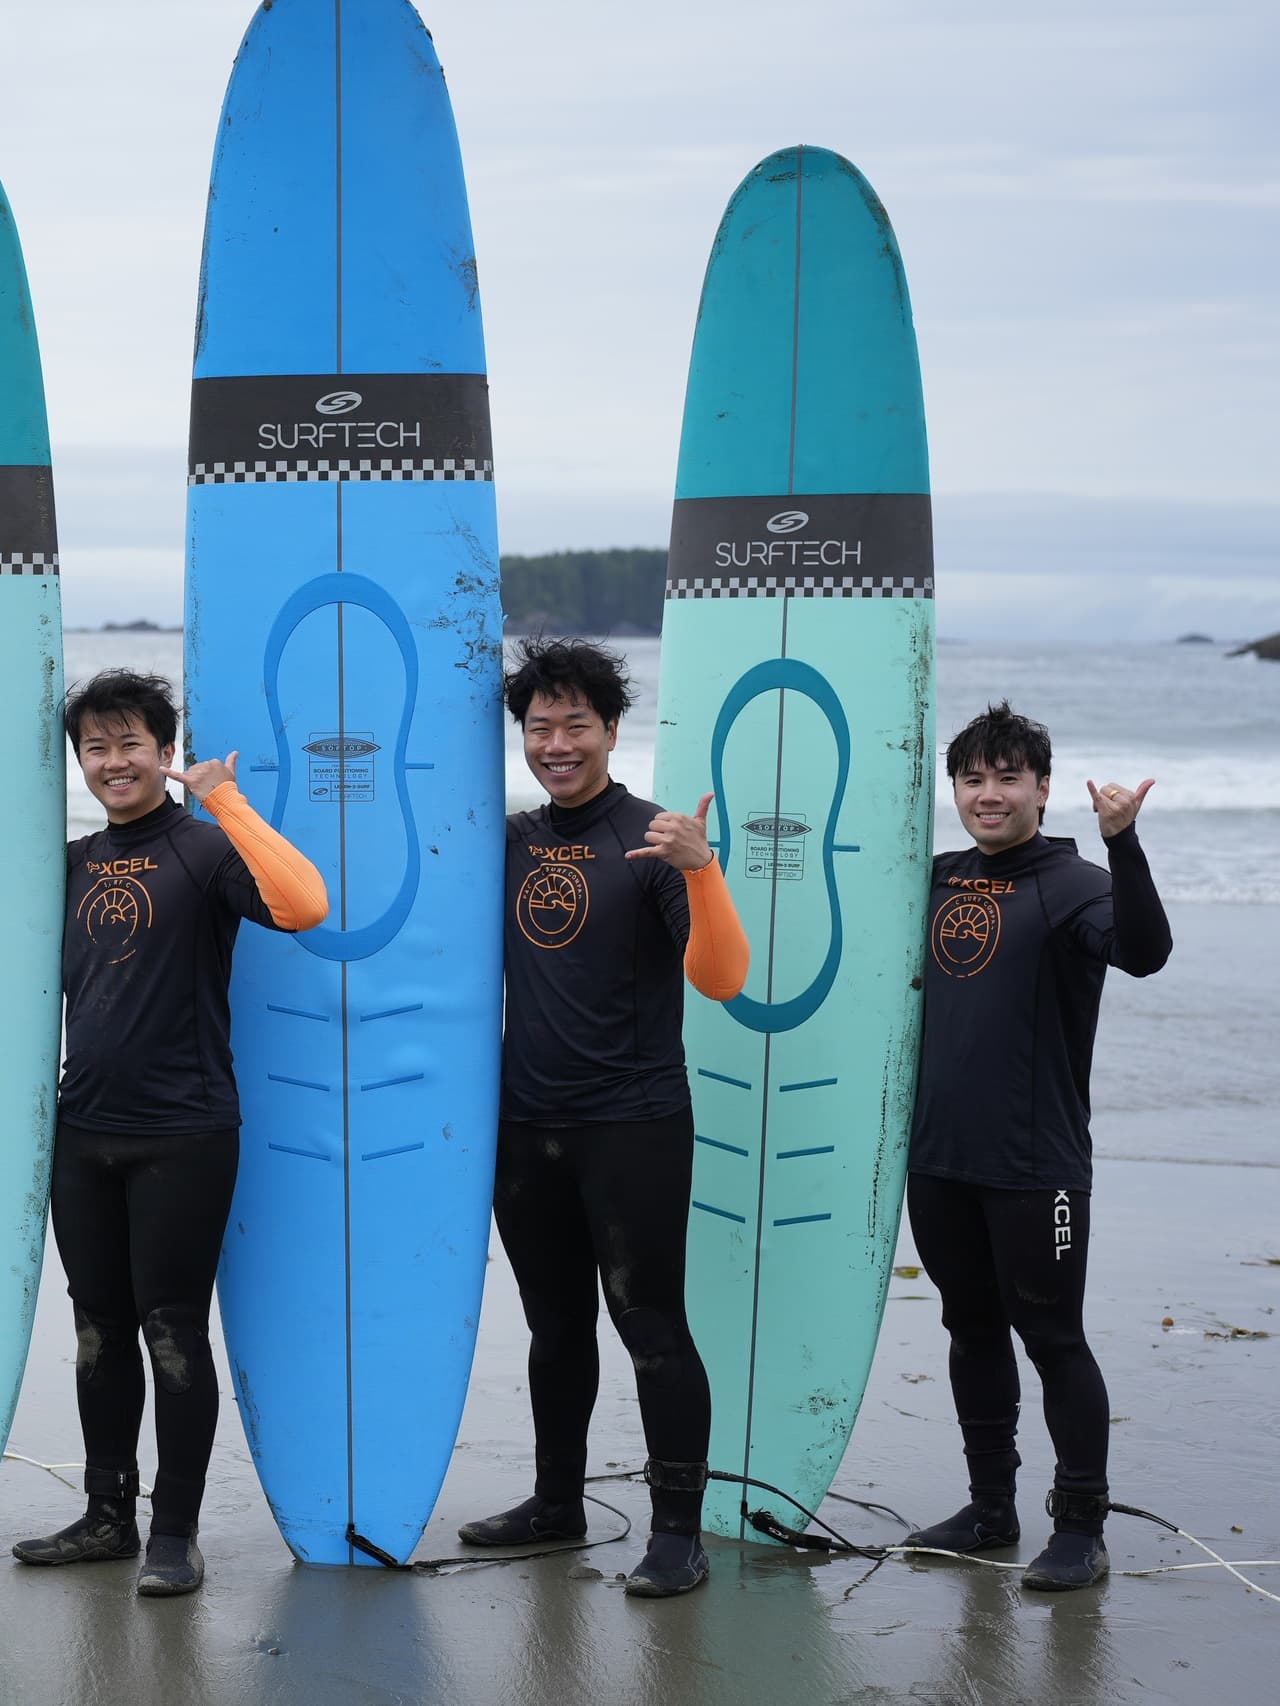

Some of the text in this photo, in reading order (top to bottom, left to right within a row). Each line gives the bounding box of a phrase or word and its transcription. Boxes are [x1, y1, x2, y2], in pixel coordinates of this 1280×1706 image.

[258, 421, 421, 450] SURFTECH
[715, 540, 861, 567] SURFTECH
[541, 845, 596, 861] XCEL
[99, 857, 159, 876] XCEL
[960, 878, 1017, 894] XCEL
[1054, 1189, 1071, 1260] XCEL
